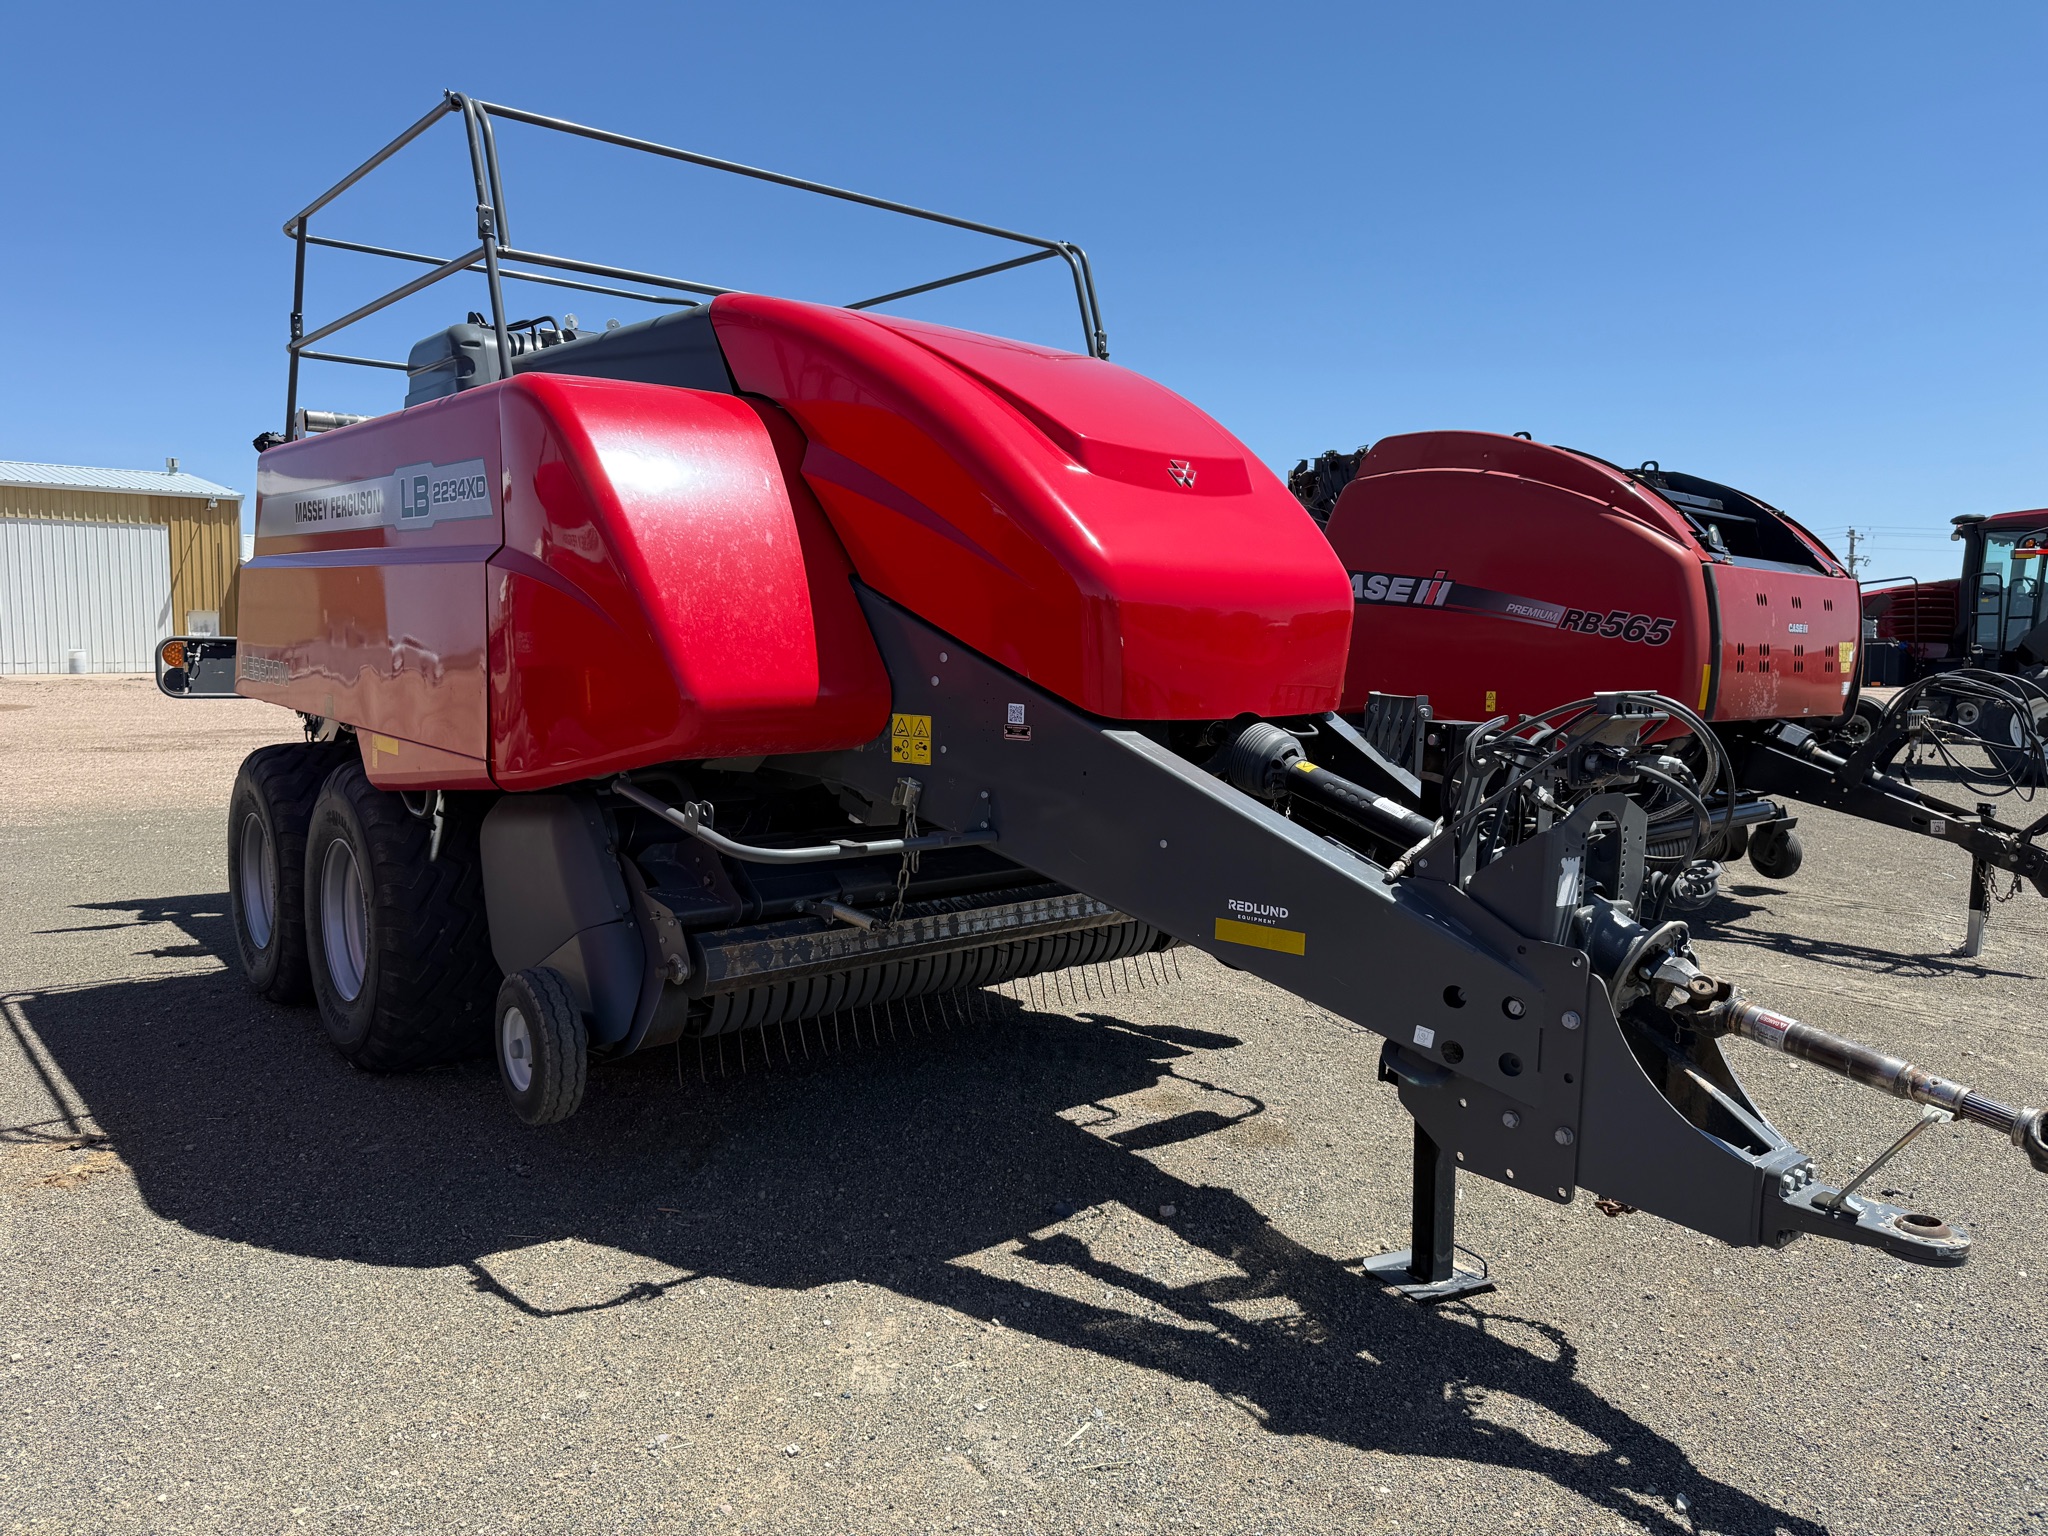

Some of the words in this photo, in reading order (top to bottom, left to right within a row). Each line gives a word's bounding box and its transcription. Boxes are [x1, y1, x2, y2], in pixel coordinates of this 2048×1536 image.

[295, 498, 328, 523] MASSEY
[331, 489, 381, 519] FERGUSON
[400, 474, 430, 520] LB
[432, 474, 487, 506] 2234XD
[1350, 573, 1416, 603] ASE
[1505, 602, 1559, 622] PREMIUM
[1559, 608, 1677, 646] RB565
[1788, 623, 1803, 633] CASE
[240, 655, 290, 688] HESSTON
[1228, 899, 1288, 918] REDLUND
[1237, 914, 1276, 925] EQUIPMENT
[1760, 1015, 1780, 1026] DANGER
